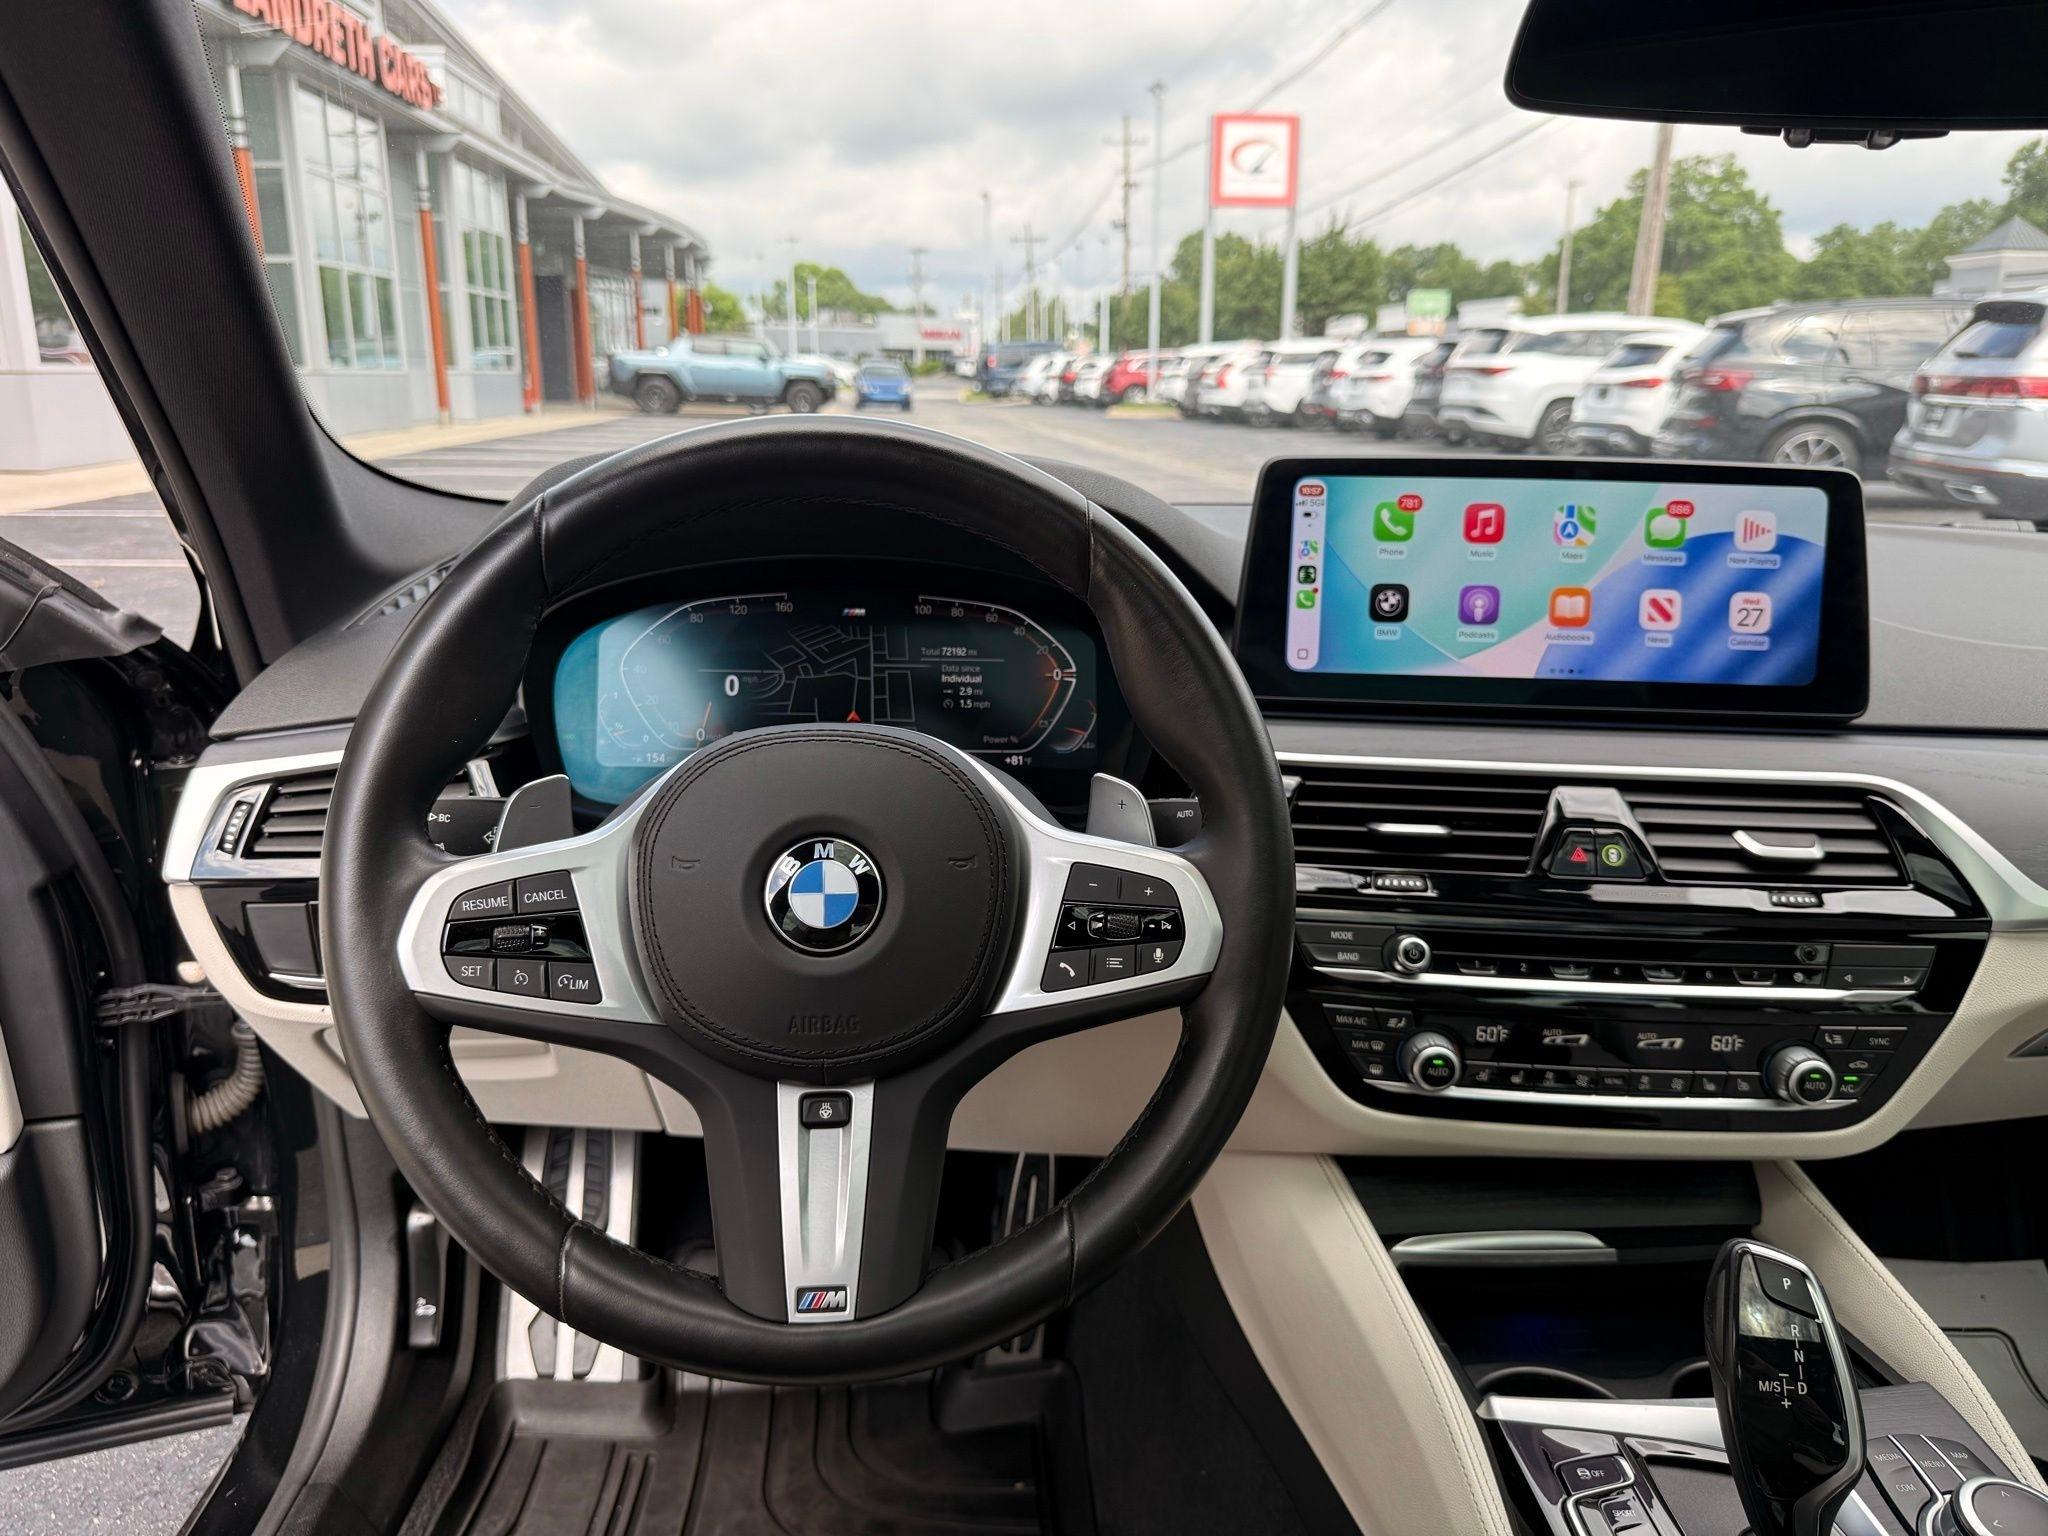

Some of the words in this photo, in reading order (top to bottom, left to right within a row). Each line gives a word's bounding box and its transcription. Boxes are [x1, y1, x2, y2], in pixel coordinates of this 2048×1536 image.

[1401, 498, 1419, 509] 781
[1378, 548, 1405, 557] Phone
[1470, 549, 1495, 558] Music
[1562, 552, 1584, 562] Maps
[1643, 553, 1683, 564] Messages
[1730, 556, 1747, 565] Now
[1750, 556, 1777, 567] Playing
[730, 605, 748, 615] 120
[775, 602, 793, 612] 160
[914, 605, 932, 615] 100
[951, 607, 964, 617] 80
[690, 613, 703, 623] 80
[986, 614, 998, 623] 60
[1736, 608, 1764, 627] 27
[1013, 627, 1026, 636] 40
[1376, 628, 1398, 637] BMW
[1459, 631, 1495, 640] Podcasts
[658, 636, 671, 645] 60
[1545, 633, 1591, 642] Audiobooks
[1648, 636, 1669, 644] News
[1731, 638, 1766, 648] Calendar
[921, 647, 940, 656] Total
[941, 646, 967, 656] 72192
[1036, 645, 1048, 655] 20
[941, 665, 958, 673] Data
[961, 665, 980, 673] since
[941, 674, 982, 683] Individual
[1053, 671, 1062, 681] 0
[724, 675, 740, 697] 0
[959, 687, 973, 696] 2.9
[960, 699, 973, 709] 1.5
[974, 700, 991, 710] mph
[696, 728, 706, 741] 0
[983, 735, 1009, 744] Power
[646, 752, 665, 763] 154
[438, 814, 451, 823] BC
[1176, 809, 1194, 819] AUTO
[780, 842, 871, 878] BMW
[524, 889, 568, 904] CANCEL
[462, 896, 509, 912] RESUME
[1330, 931, 1354, 940] MODE
[1337, 951, 1360, 961] BAND
[461, 965, 482, 977] SET
[1519, 962, 1528, 973] 2
[569, 979, 590, 990] LIM
[788, 1015, 861, 1035] AIRBAG
[1335, 1014, 1352, 1025] MAX
[1353, 1016, 1368, 1026] A/C
[1542, 1029, 1562, 1037] AUTO
[1637, 1032, 1657, 1040] AUTO
[1351, 1039, 1370, 1050] MAX
[1868, 1037, 1890, 1047] SYNC
[1427, 1067, 1449, 1077] AUTO
[1804, 1081, 1826, 1090] AUTO
[1840, 1084, 1855, 1093] A/C
[1782, 1277, 1791, 1290] P
[1791, 1324, 1800, 1337] R
[1794, 1350, 1805, 1363] N
[1758, 1380, 1781, 1393] M/S
[1797, 1382, 1808, 1395] D
[1874, 1452, 1902, 1463] MEDIA
[1950, 1451, 1969, 1461] MAP
[1919, 1459, 1946, 1469] MENU
[1591, 1469, 1606, 1478] OFF
[1895, 1482, 1917, 1493] COM
[1612, 1508, 1637, 1518] SPORT
